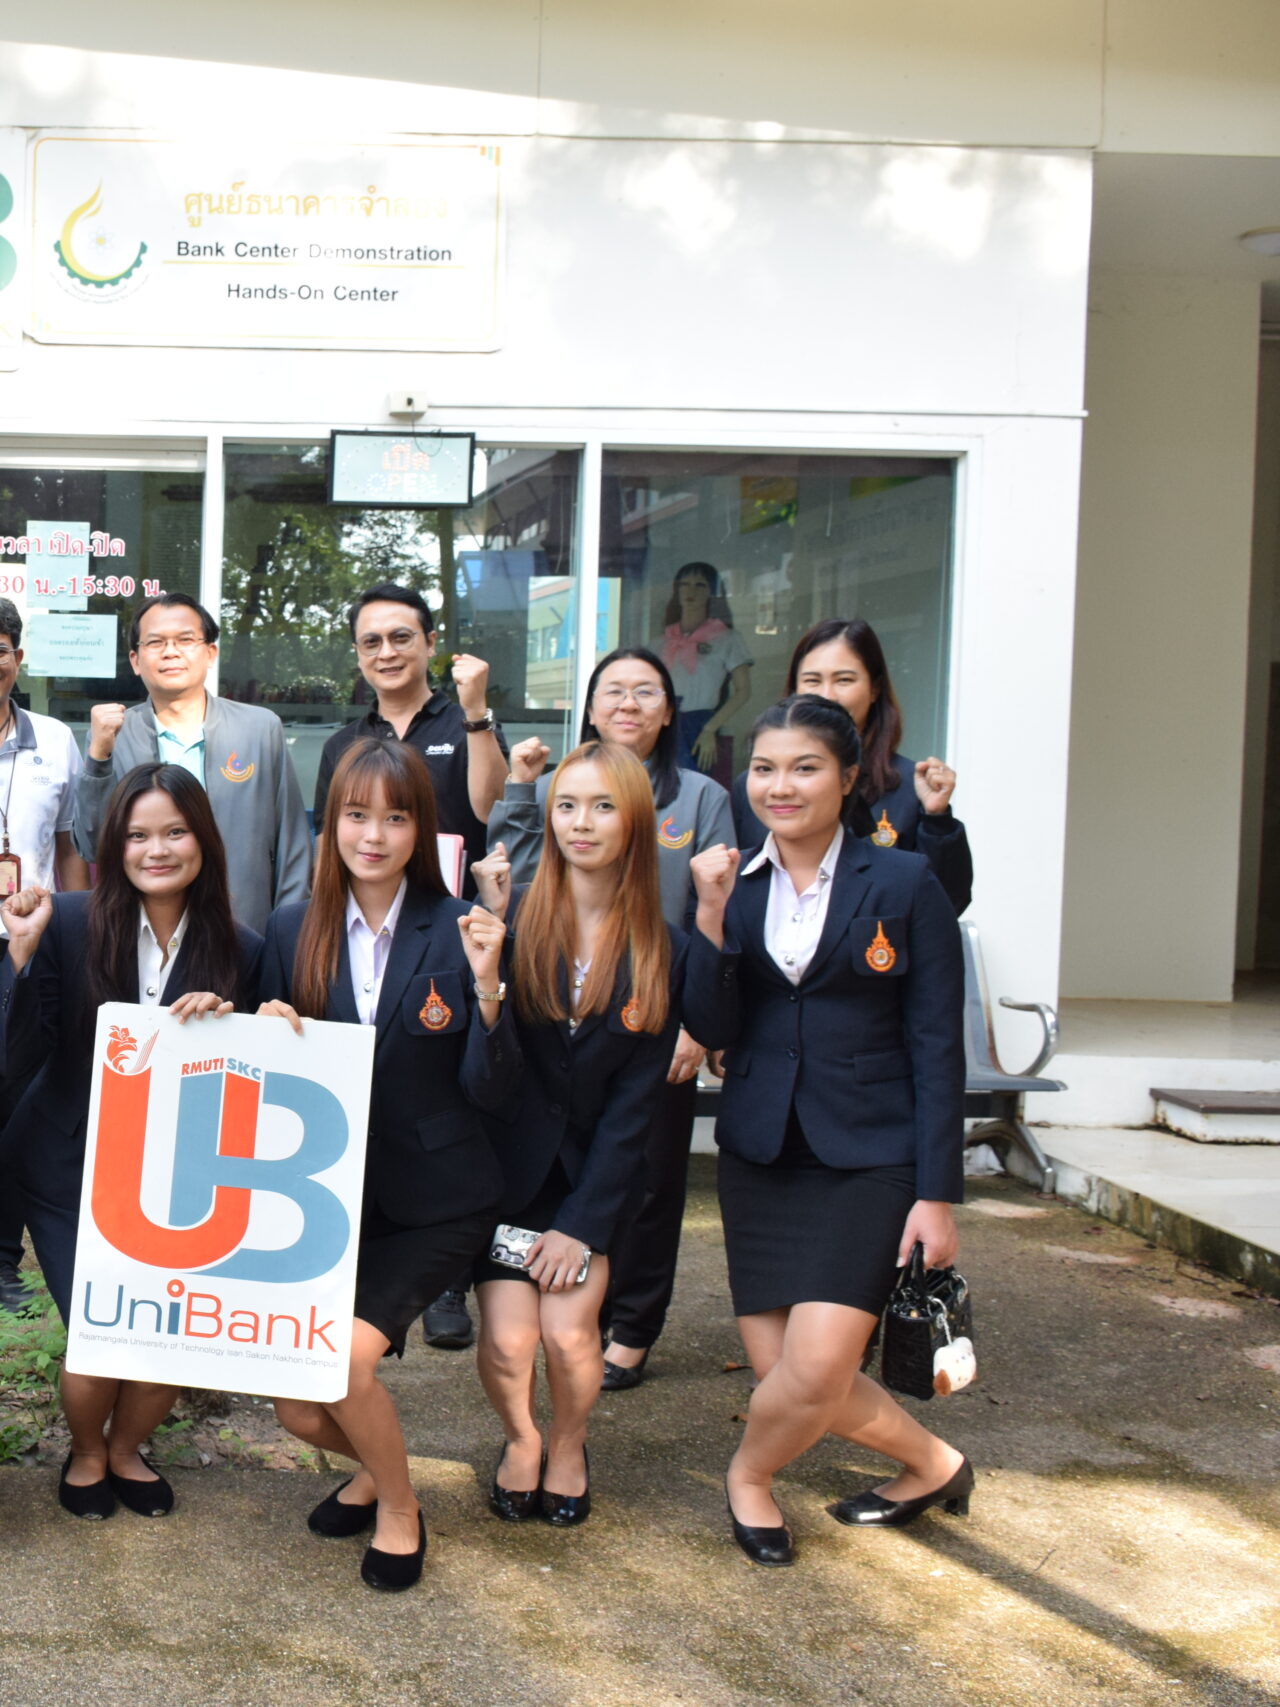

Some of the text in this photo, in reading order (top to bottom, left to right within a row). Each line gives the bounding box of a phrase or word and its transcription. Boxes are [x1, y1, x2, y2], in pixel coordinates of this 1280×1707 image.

[176, 241, 452, 261] Bank Center Demonstration
[227, 284, 399, 302] Hands-On Center
[367, 472, 438, 494] OPEN
[49, 531, 125, 557] เปิด-ปิด
[35, 575, 136, 597] น.-15:30
[181, 1057, 262, 1081] RMUTI SKC
[83, 1279, 338, 1353] UniBank
[78, 1331, 339, 1369] Rajamangala University of Technology Isan Sakon Nakhon Campus
